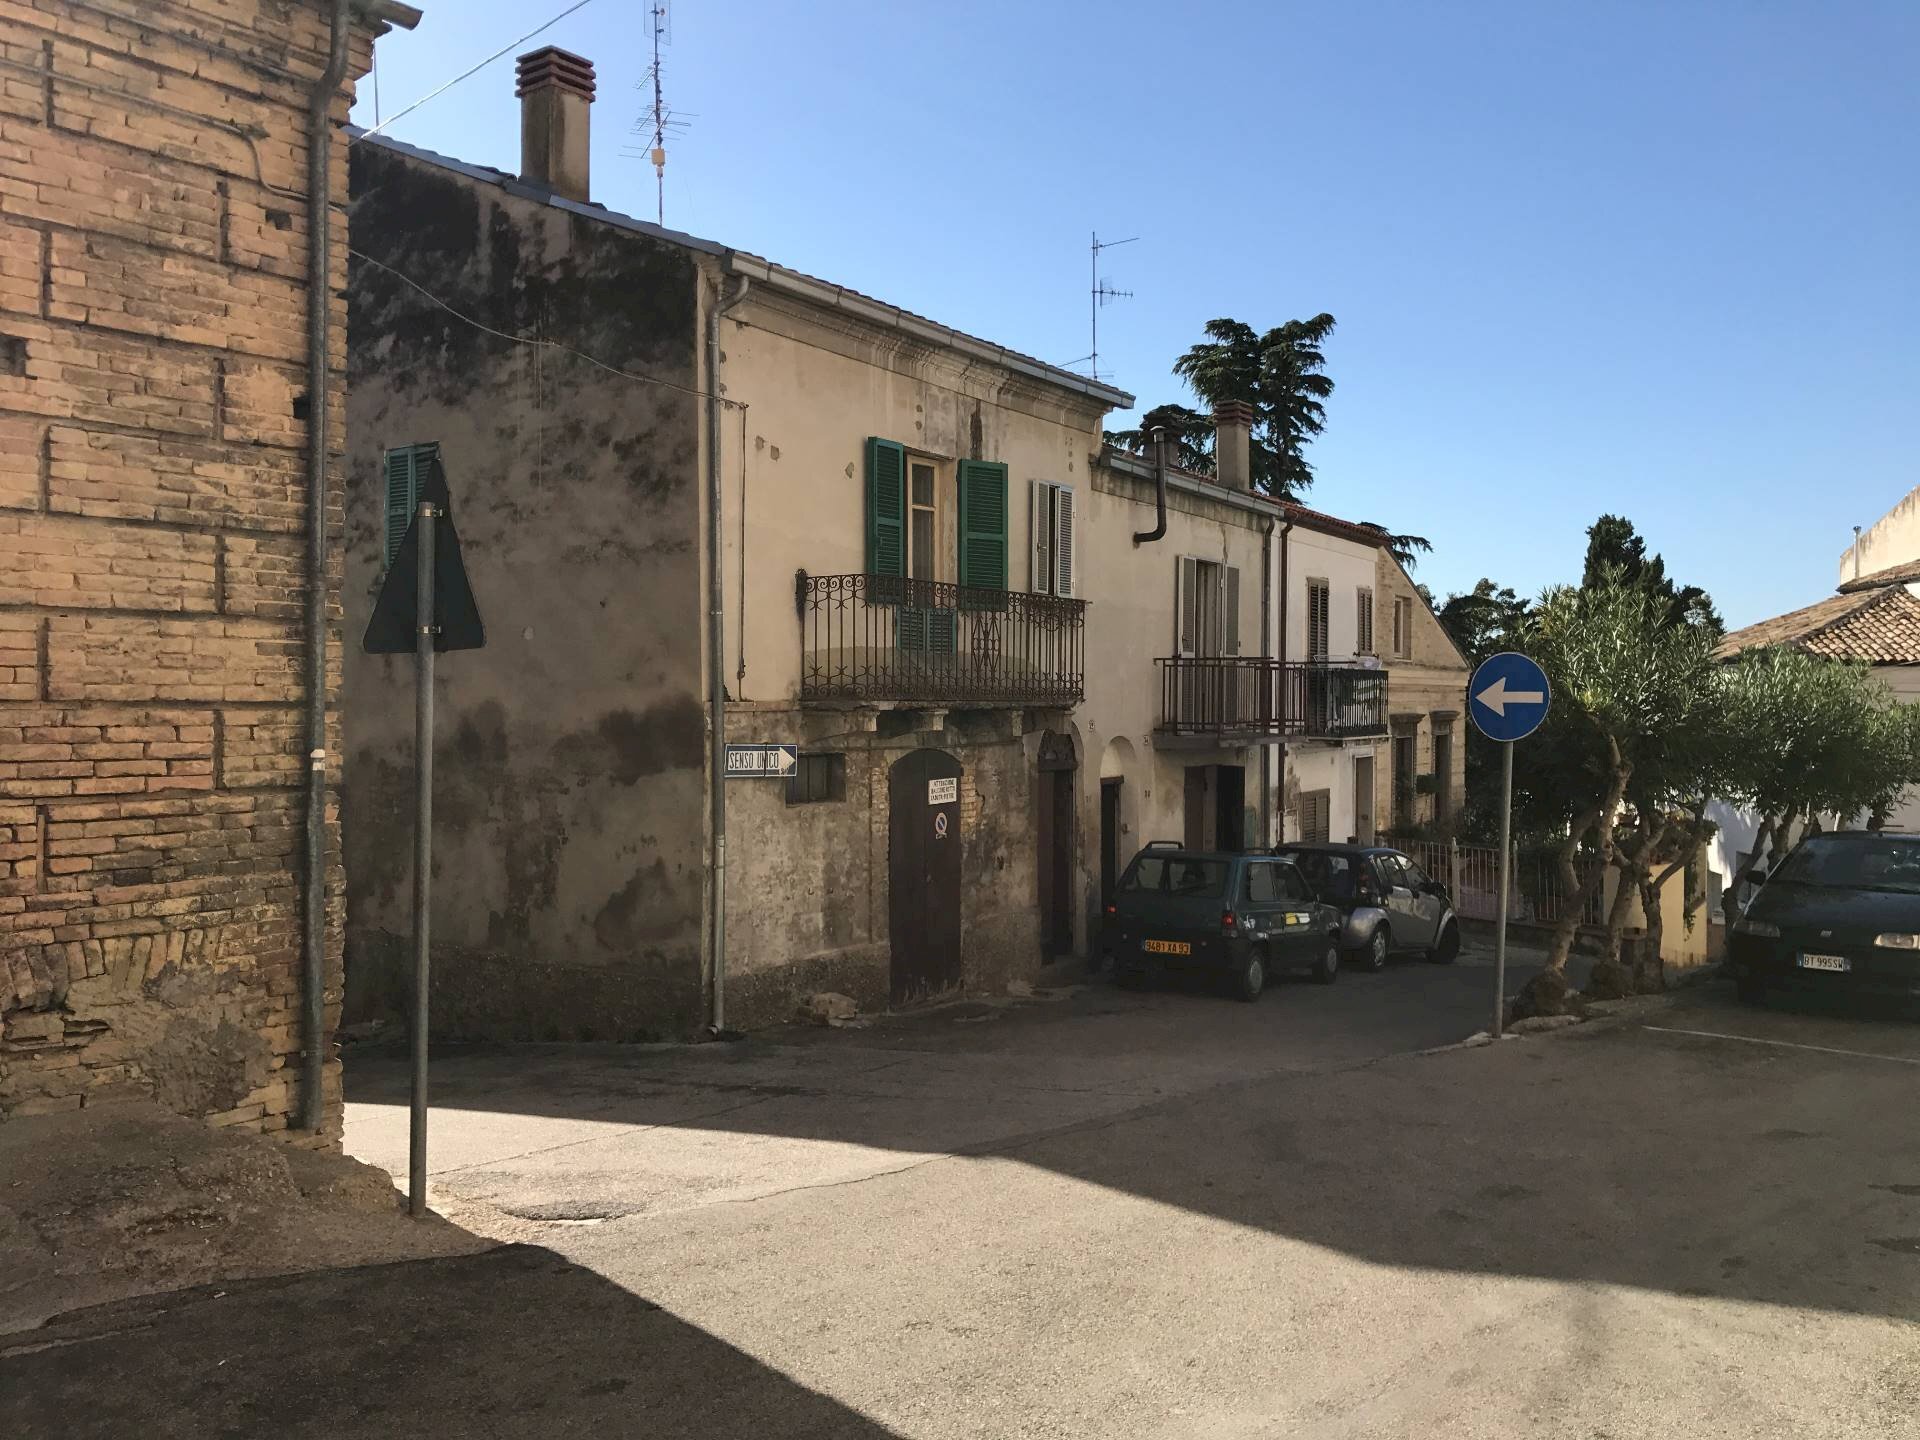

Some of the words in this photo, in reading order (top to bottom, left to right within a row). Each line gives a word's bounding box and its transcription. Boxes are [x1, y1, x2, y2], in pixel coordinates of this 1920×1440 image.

[729, 752, 754, 769] SENSO
[757, 752, 779, 769] UNICO
[1804, 956, 1814, 965] BT
